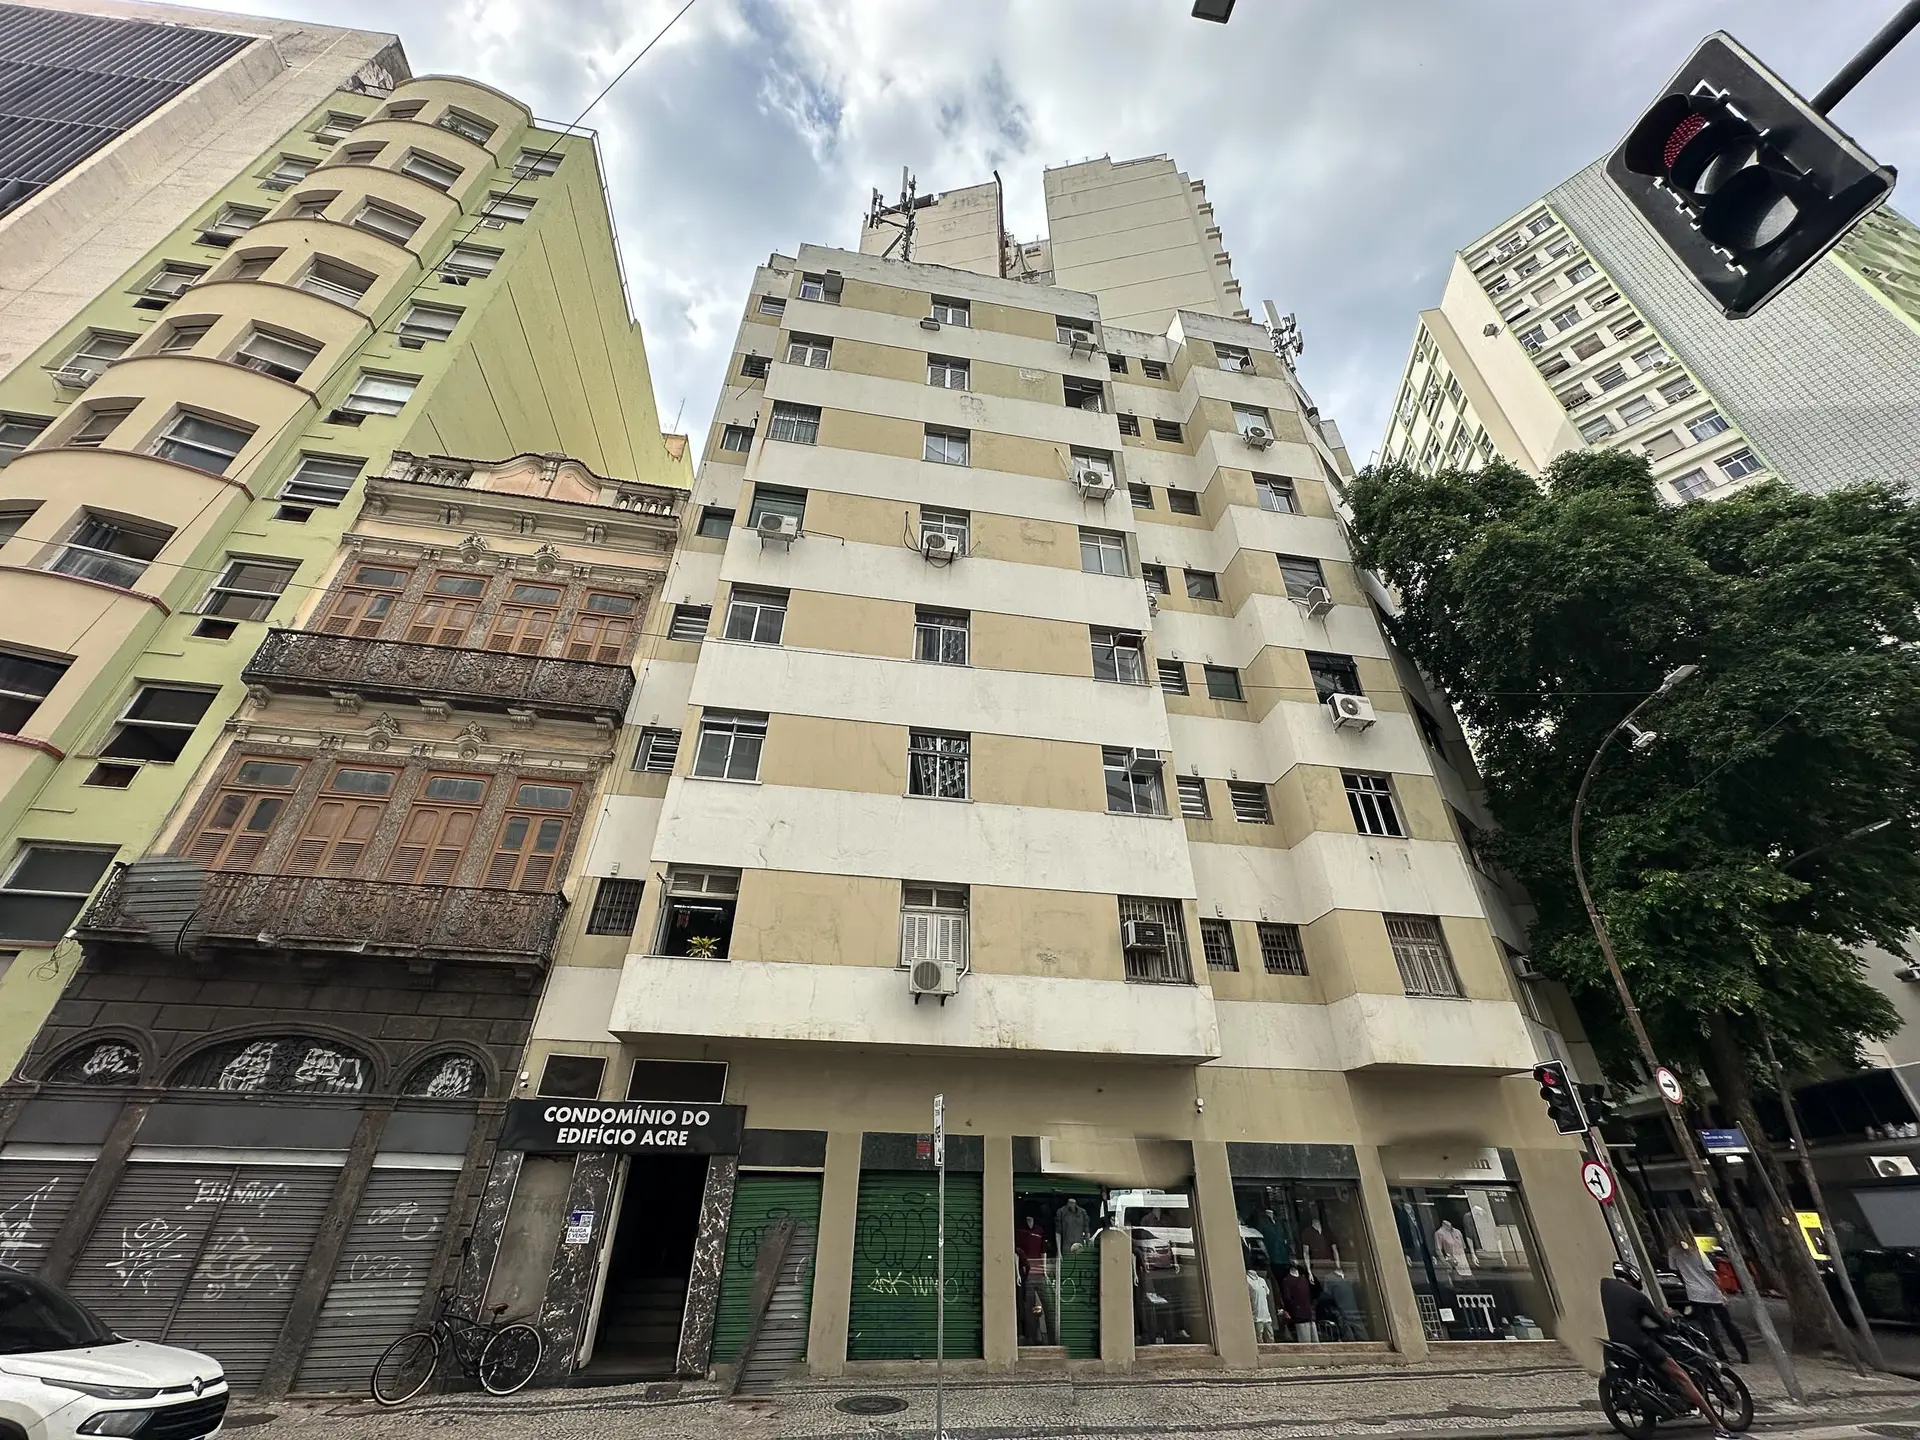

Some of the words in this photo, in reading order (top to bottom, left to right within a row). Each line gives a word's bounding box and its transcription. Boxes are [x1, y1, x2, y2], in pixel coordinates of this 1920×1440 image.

[543, 1105, 677, 1126] CONDOMÍNIO
[681, 1110, 710, 1126] DO
[556, 1124, 637, 1146] EDIFÍCIO
[640, 1129, 688, 1147] ACRE
